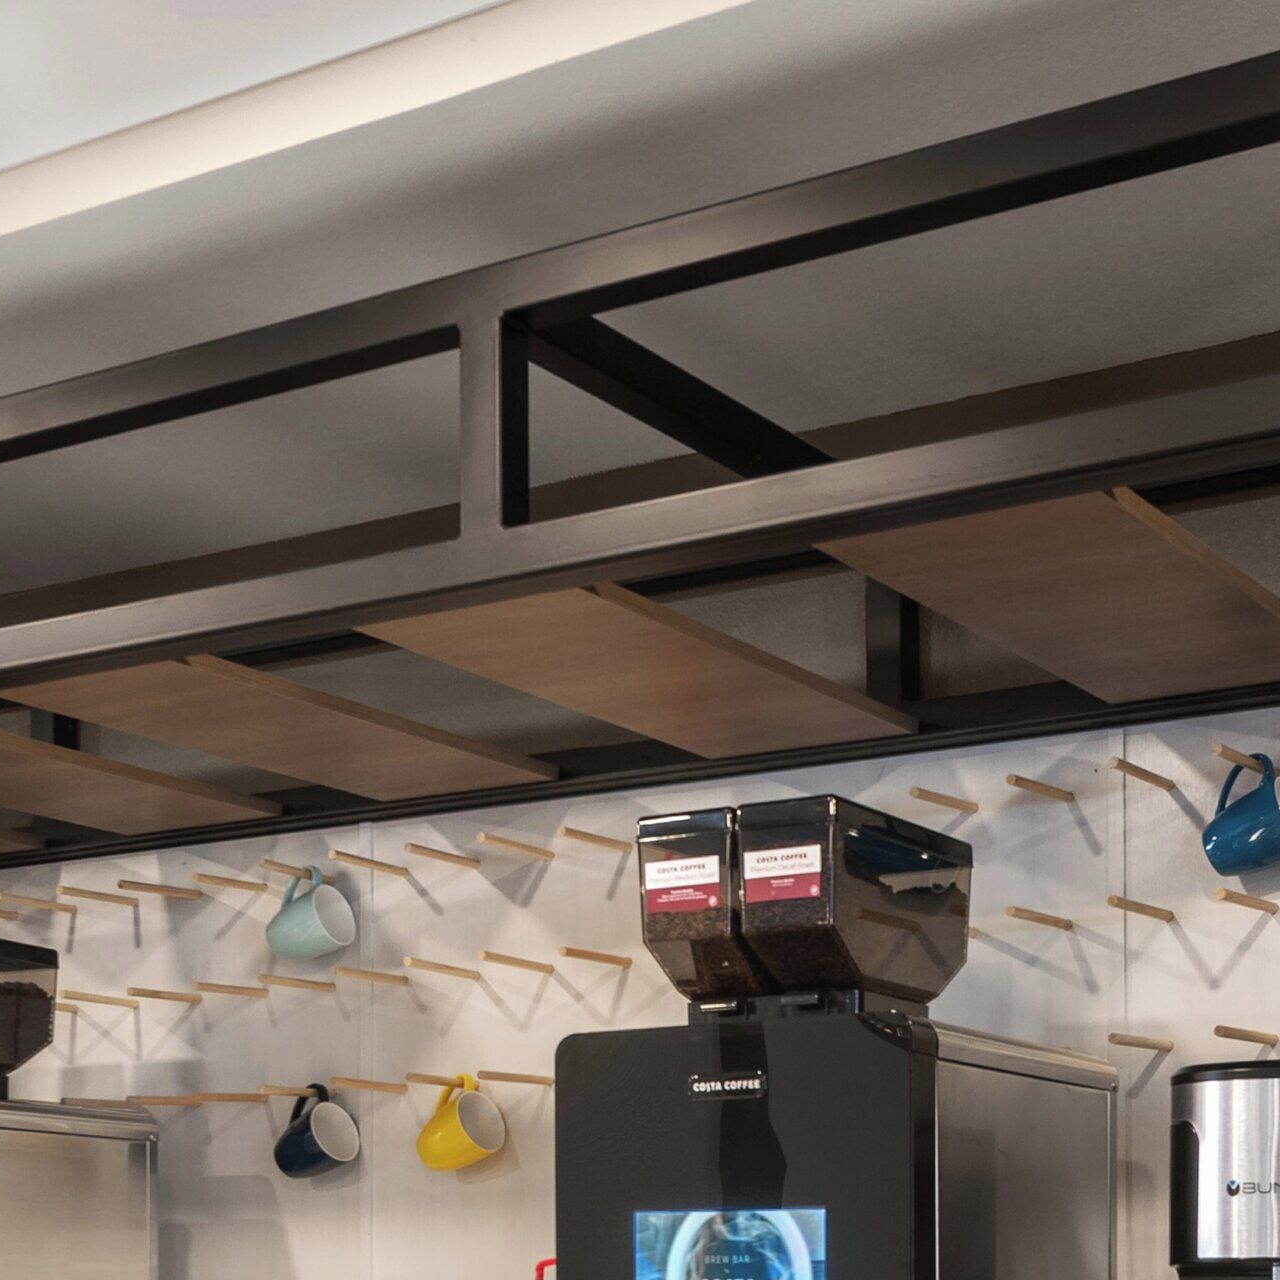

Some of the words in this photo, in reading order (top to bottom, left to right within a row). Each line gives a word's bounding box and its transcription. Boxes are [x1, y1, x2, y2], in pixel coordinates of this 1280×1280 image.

[756, 855, 778, 865] COSTA
[780, 852, 807, 861] COFFEE
[657, 865, 677, 874] COSTA
[680, 863, 706, 871] COFFEE
[693, 1081, 723, 1093] COSTA
[723, 1079, 761, 1090] COFFEE
[704, 1254, 730, 1265] BREW
[731, 1254, 751, 1265] BAR
